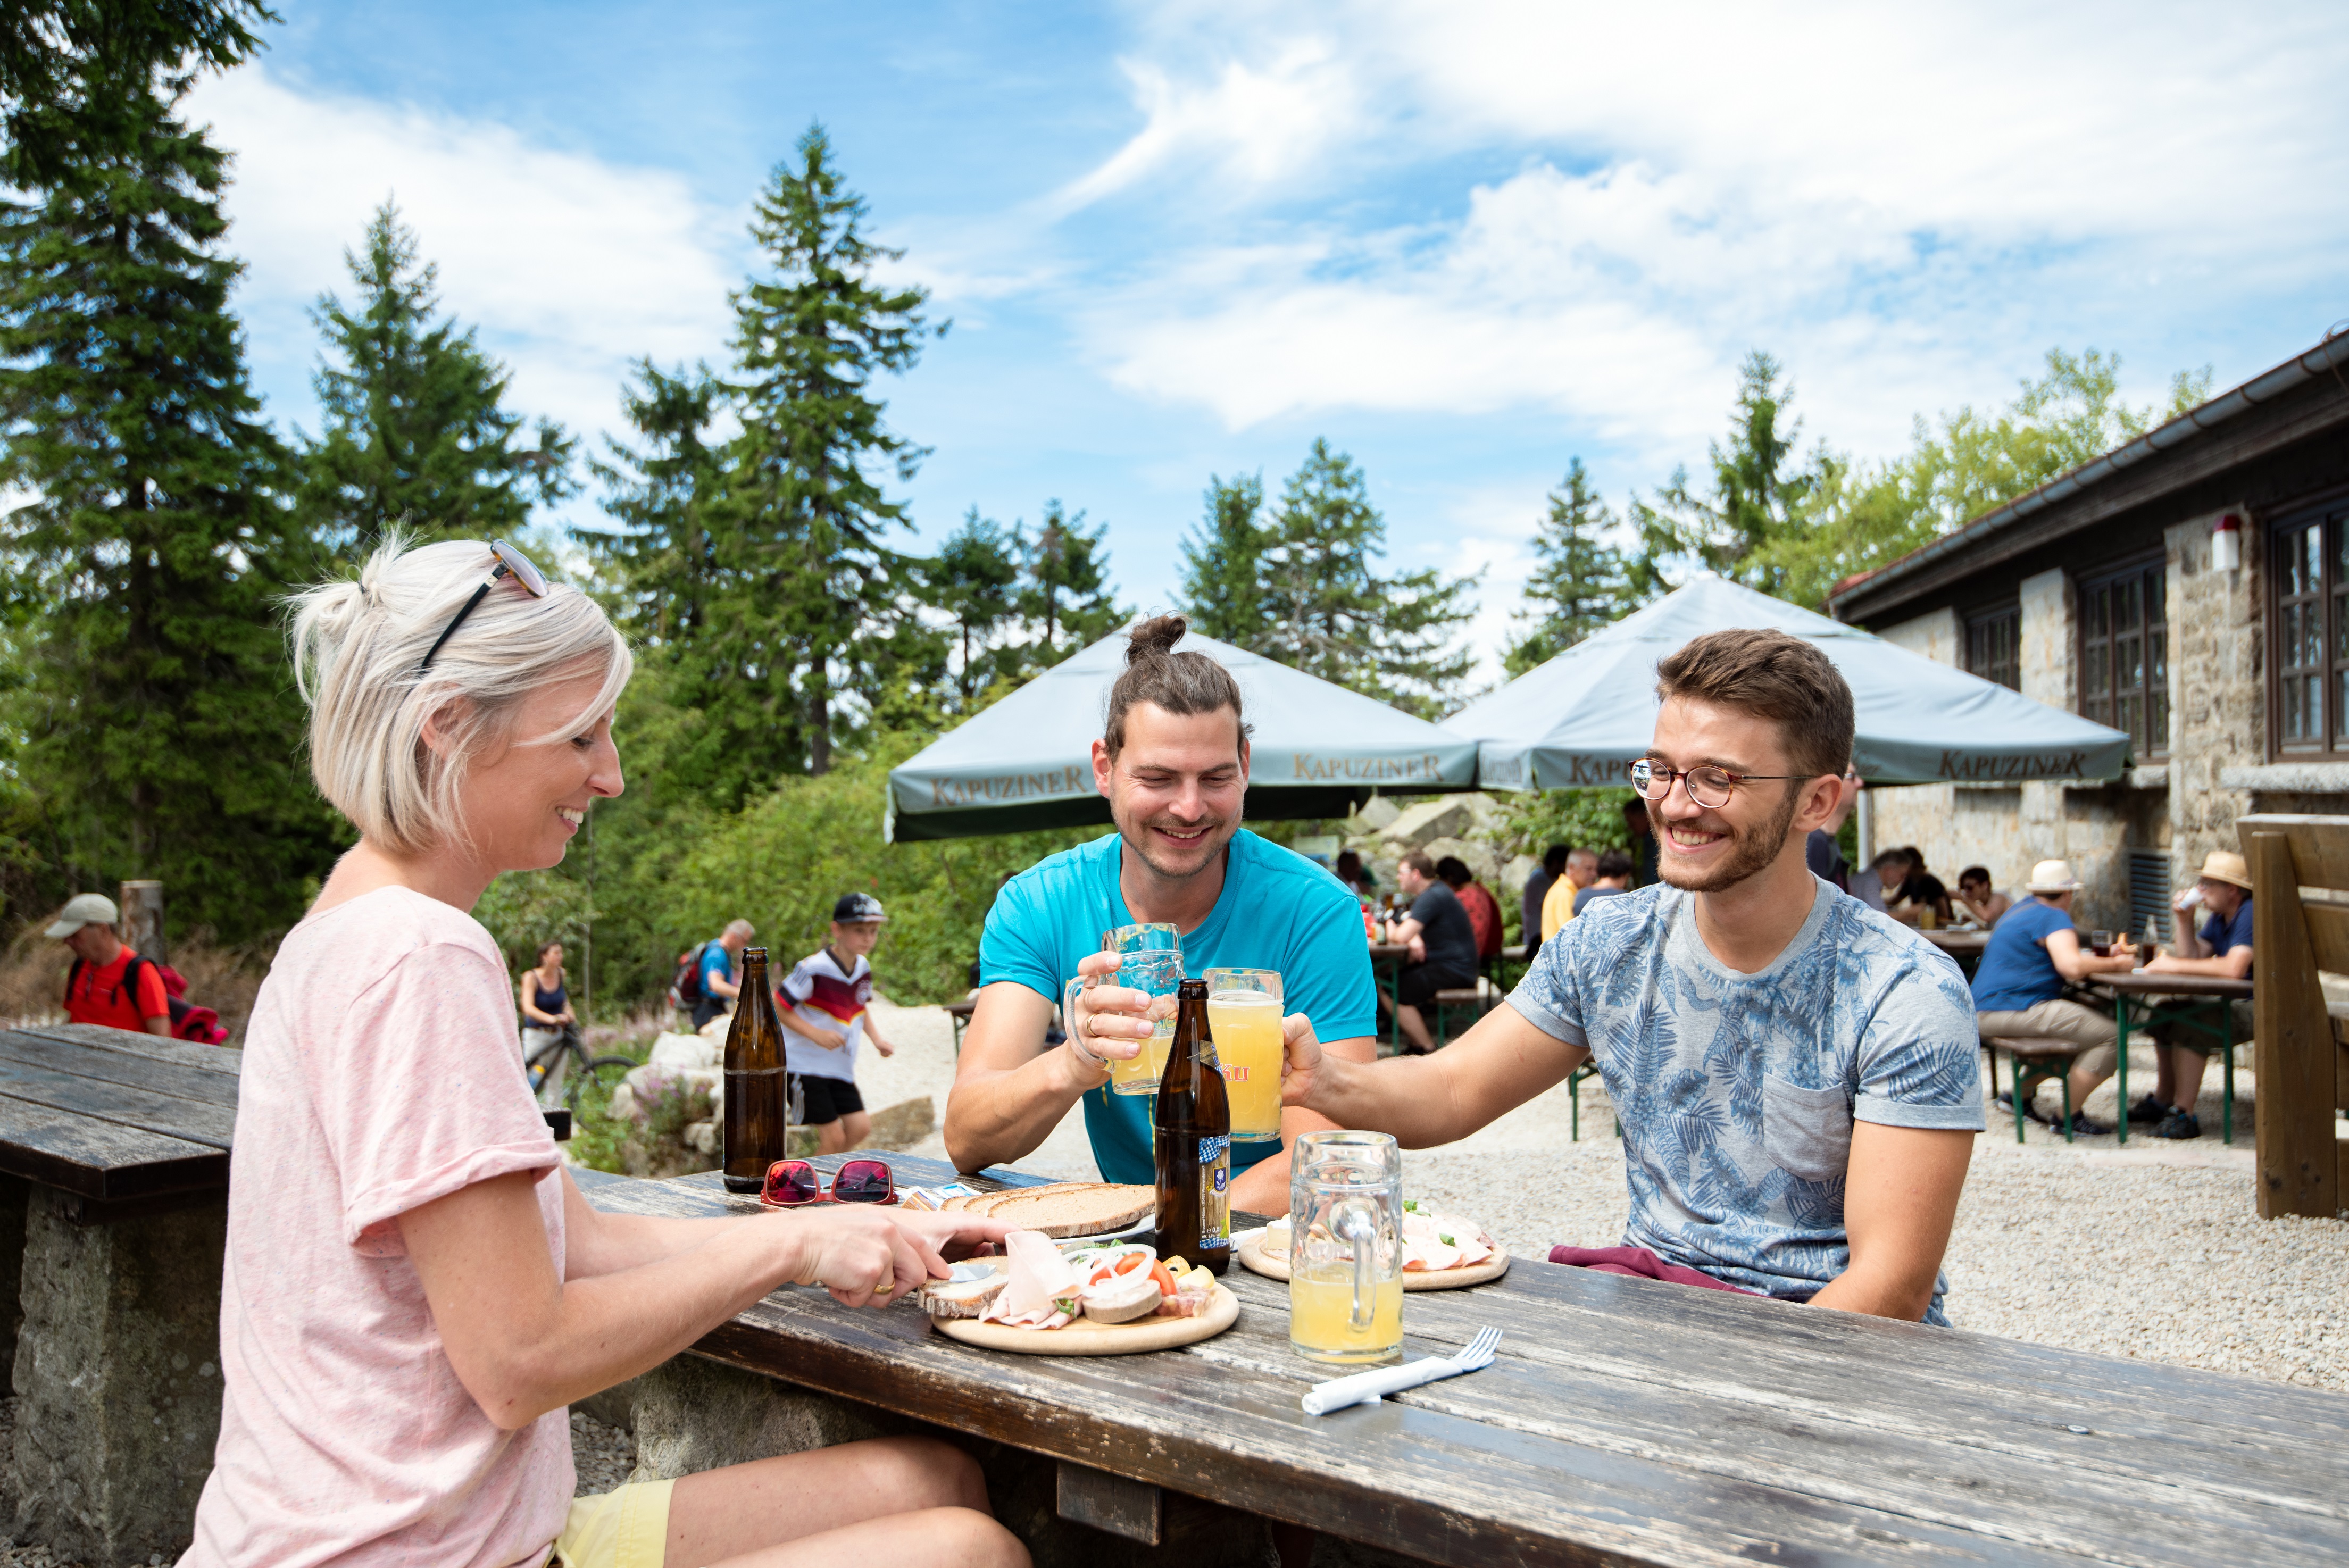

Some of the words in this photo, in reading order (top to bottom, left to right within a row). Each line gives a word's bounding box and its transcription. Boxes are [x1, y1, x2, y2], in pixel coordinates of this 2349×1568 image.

[1293, 753, 1445, 781] KAPUZINER
[1938, 749, 2086, 779] KAPUZINER
[930, 765, 1088, 806] KAPUZINER
[1220, 1063, 1250, 1082] KU
